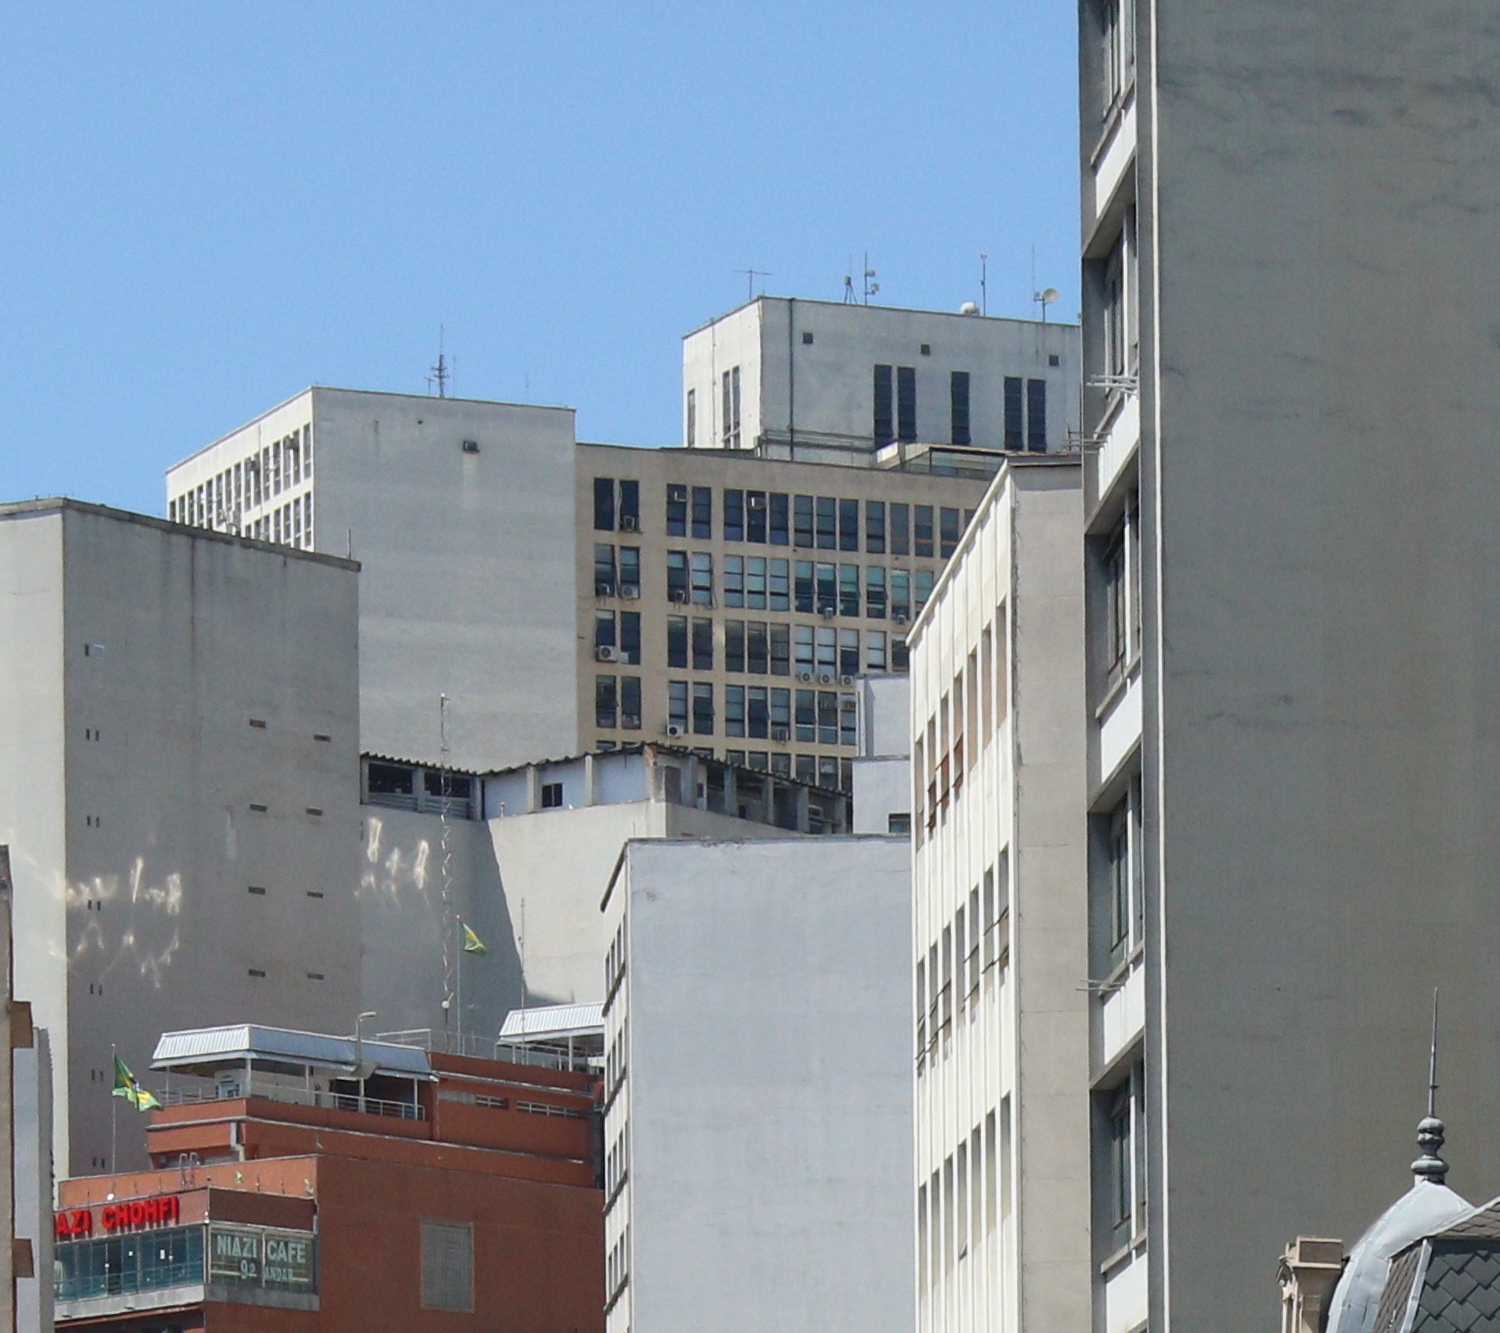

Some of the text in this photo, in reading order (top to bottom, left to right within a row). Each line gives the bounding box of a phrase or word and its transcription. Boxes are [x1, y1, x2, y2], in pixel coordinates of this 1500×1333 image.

[54, 1195, 180, 1235] AZI CHOHFI
[216, 1235, 257, 1259] NIAZI
